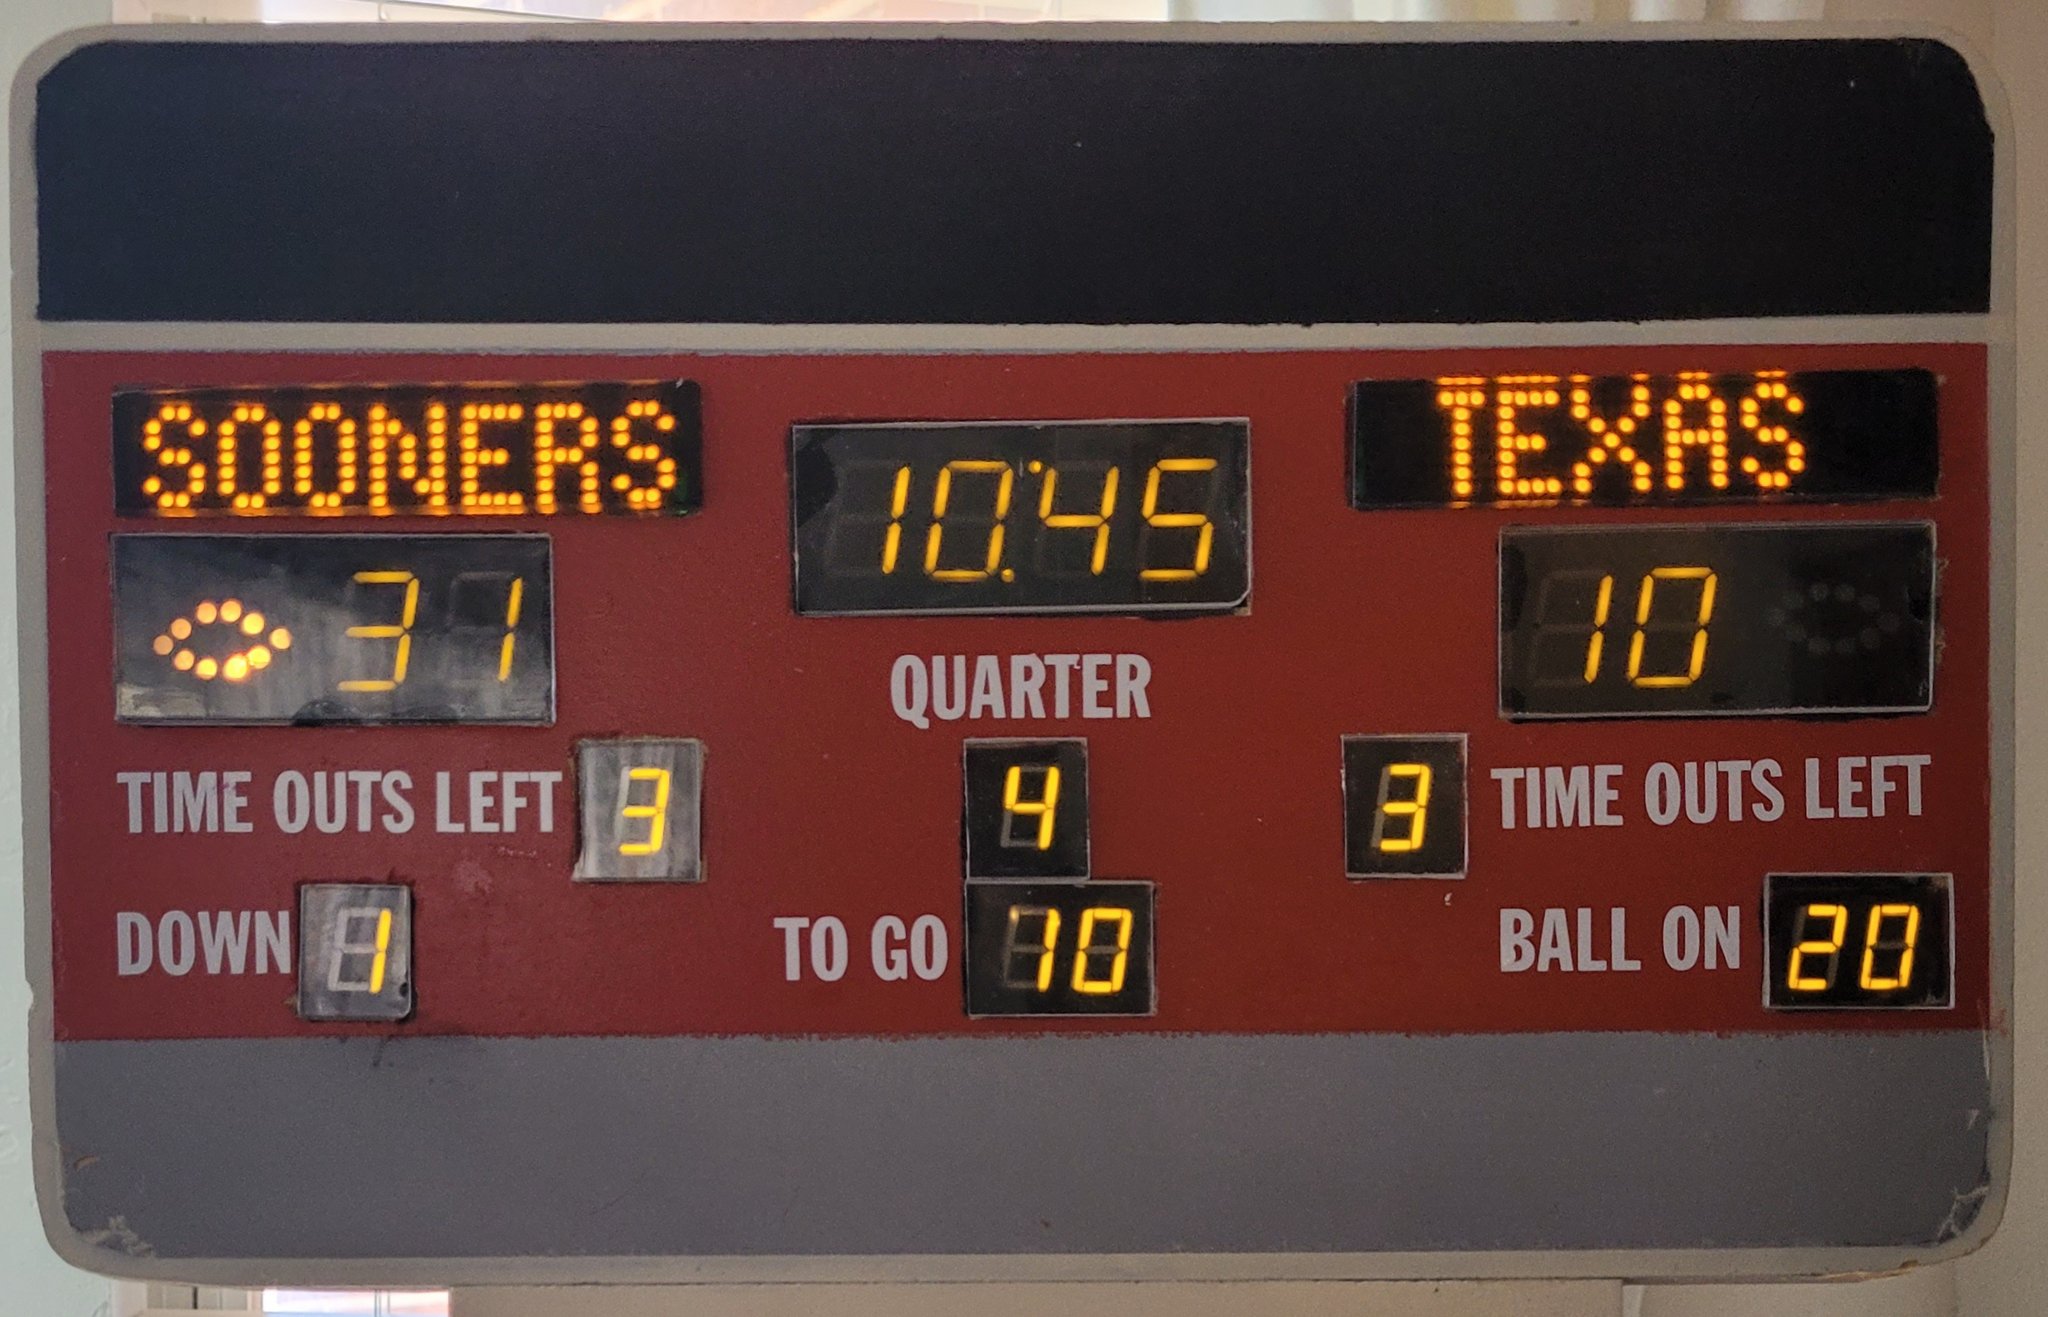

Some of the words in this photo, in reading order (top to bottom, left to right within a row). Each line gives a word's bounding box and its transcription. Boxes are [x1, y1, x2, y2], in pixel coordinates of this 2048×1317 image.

[142, 400, 676, 512] SOONERS
[1435, 379, 1807, 496] TEXAS
[338, 571, 522, 692] 31
[1584, 567, 1717, 686] 10
[891, 653, 1151, 729] QUARTER
[116, 771, 254, 833] TIME
[274, 770, 415, 834] OUTS
[436, 771, 563, 833] LEFT
[617, 766, 672, 856] 3
[1003, 765, 1061, 850] 4
[1380, 763, 1432, 852] 3
[1491, 764, 1623, 829] TIME
[1646, 759, 1785, 825] OUTS
[1806, 754, 1931, 819] LEFT
[117, 910, 291, 976] DOWN
[774, 916, 848, 982] TO
[871, 914, 948, 981] GO
[1034, 907, 1134, 994] 10
[1500, 907, 1641, 972] BALL
[1664, 905, 1740, 971] ON
[1787, 903, 1920, 991] 20
